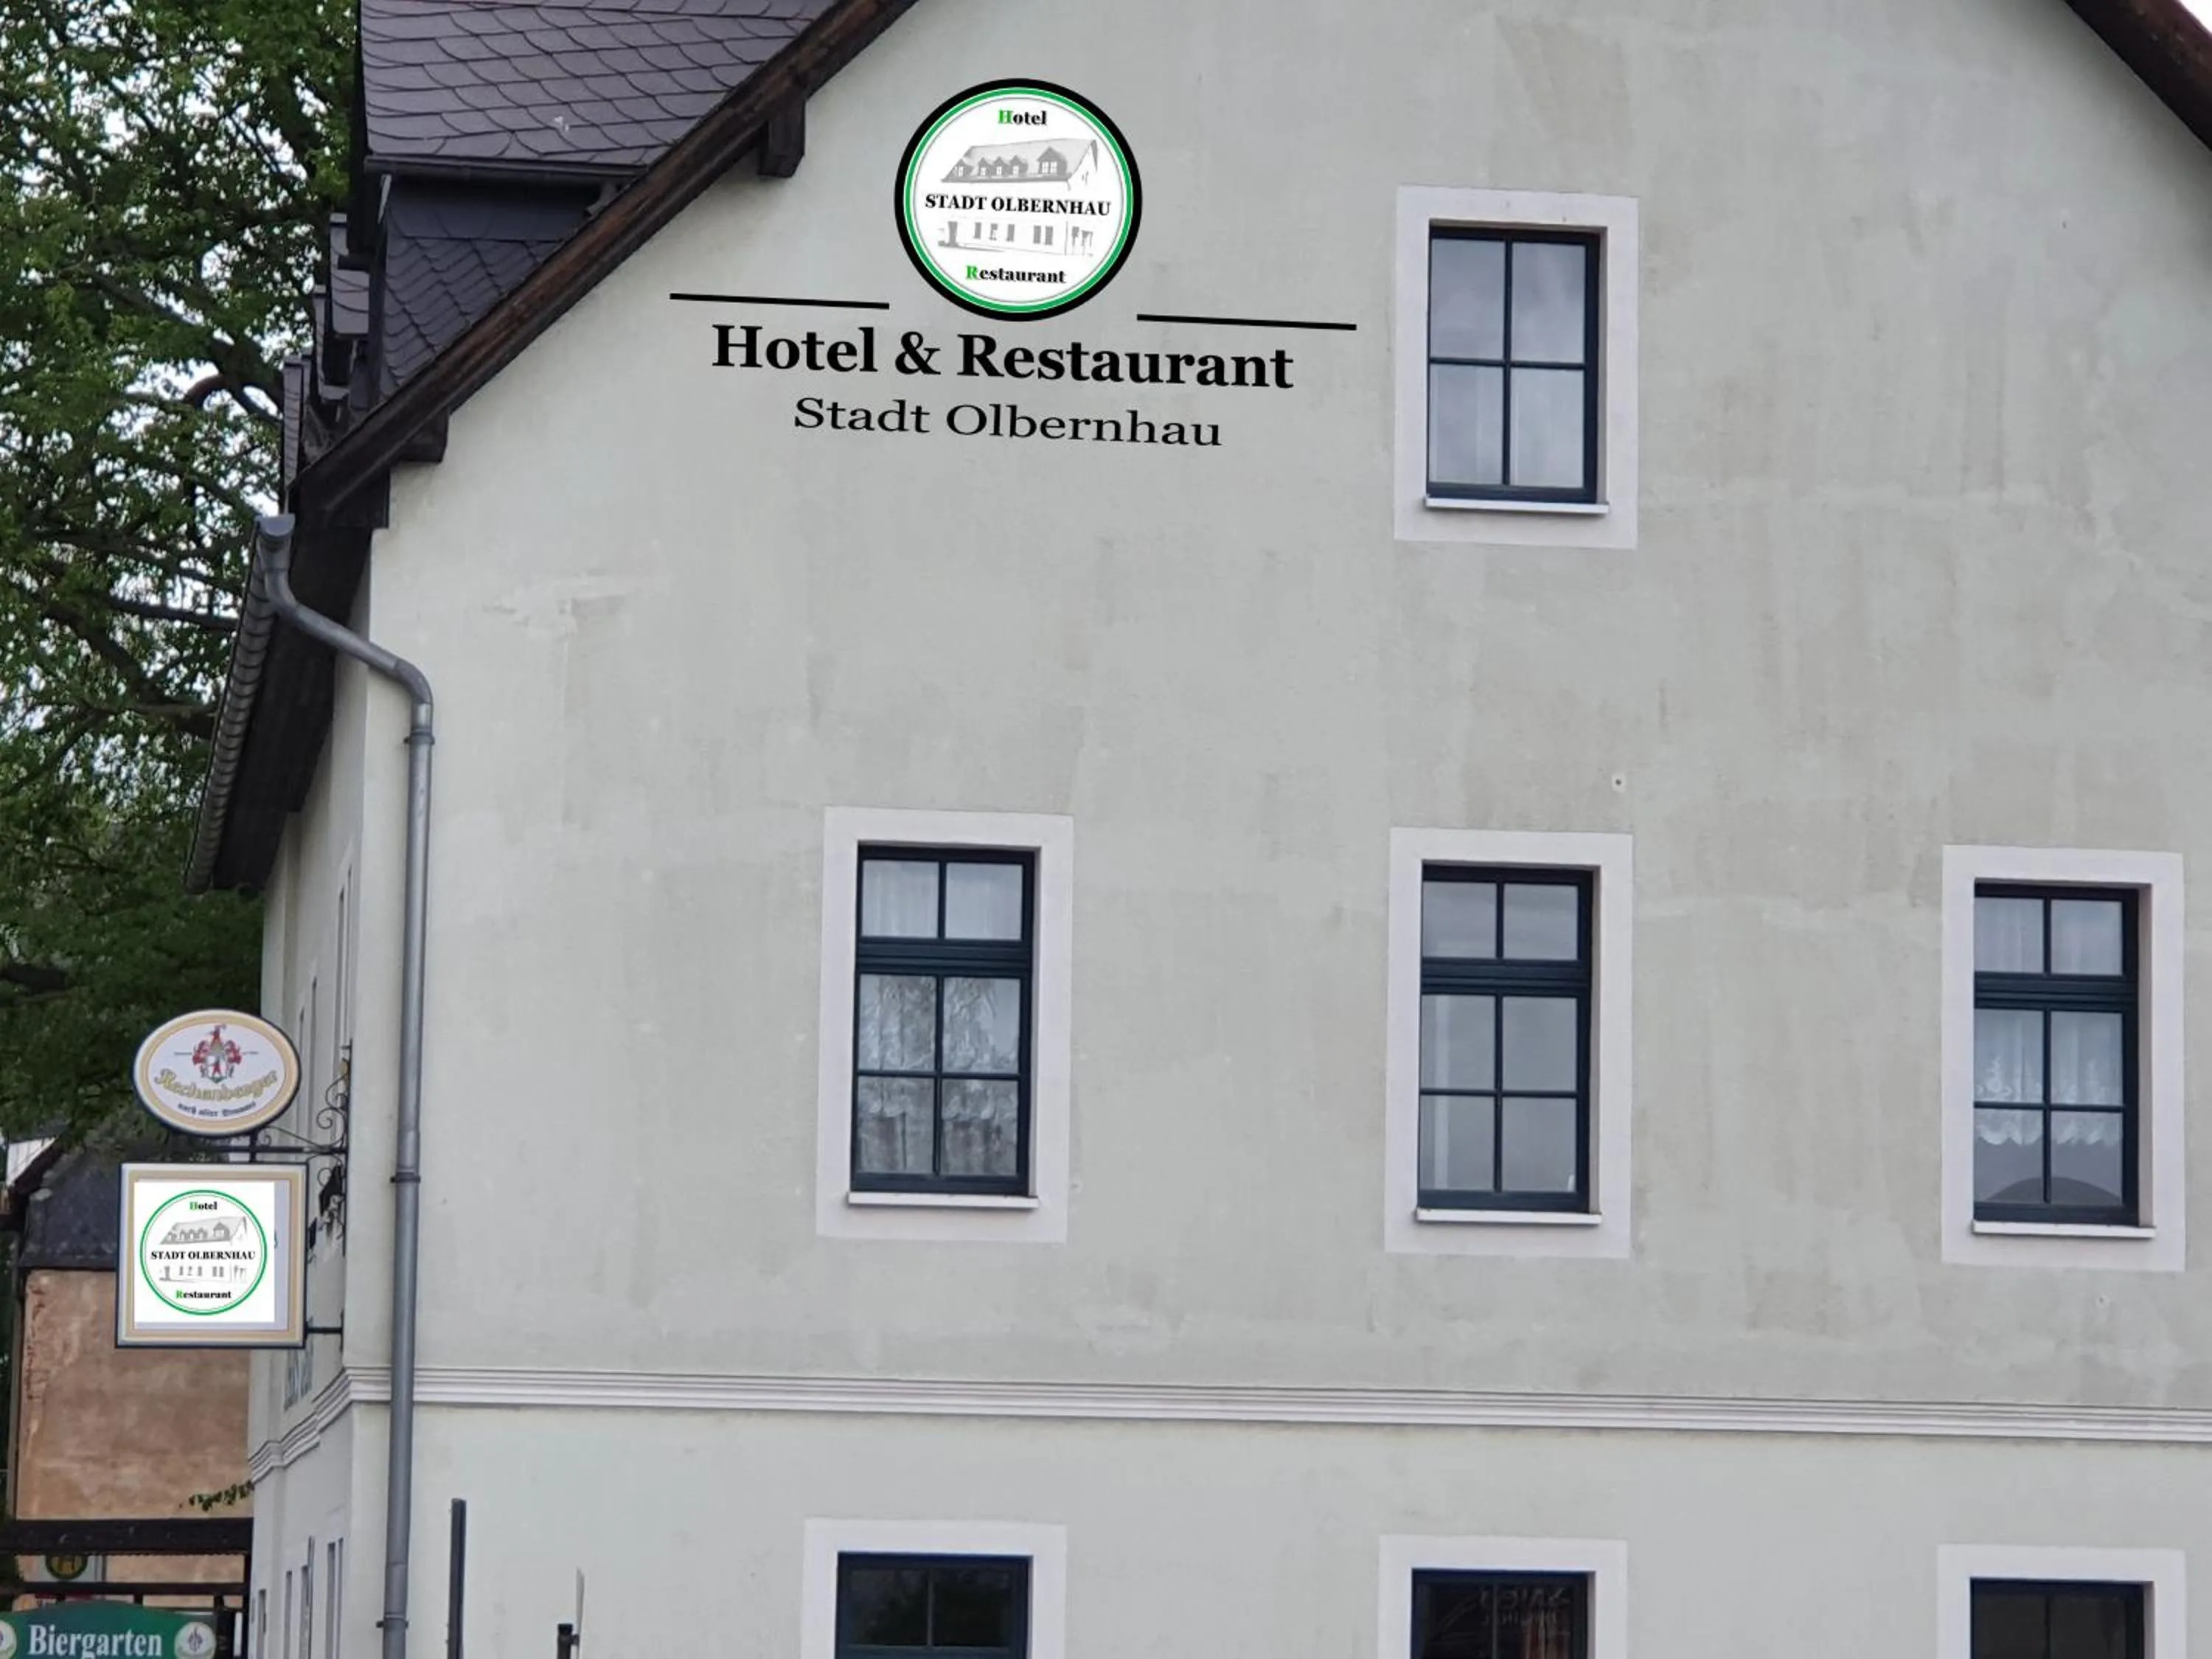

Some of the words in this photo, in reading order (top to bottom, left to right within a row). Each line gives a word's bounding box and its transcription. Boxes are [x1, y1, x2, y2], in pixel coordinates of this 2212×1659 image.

[998, 109, 1047, 125] Hotel
[925, 194, 987, 210] STADT
[991, 196, 1111, 216] OLBERNHAU
[965, 265, 1066, 284] Restaurant
[712, 324, 878, 372] Hotel
[894, 331, 942, 376] &
[956, 333, 1295, 389] Restaurant
[793, 397, 931, 434] Stadt
[945, 403, 1222, 446] Olbernhau
[189, 1201, 218, 1211] Hotel
[150, 1251, 184, 1260] STADT
[187, 1251, 255, 1260] OLBERNHAU
[175, 1290, 232, 1299] Restaurant
[27, 1624, 162, 1659] Biergarten
